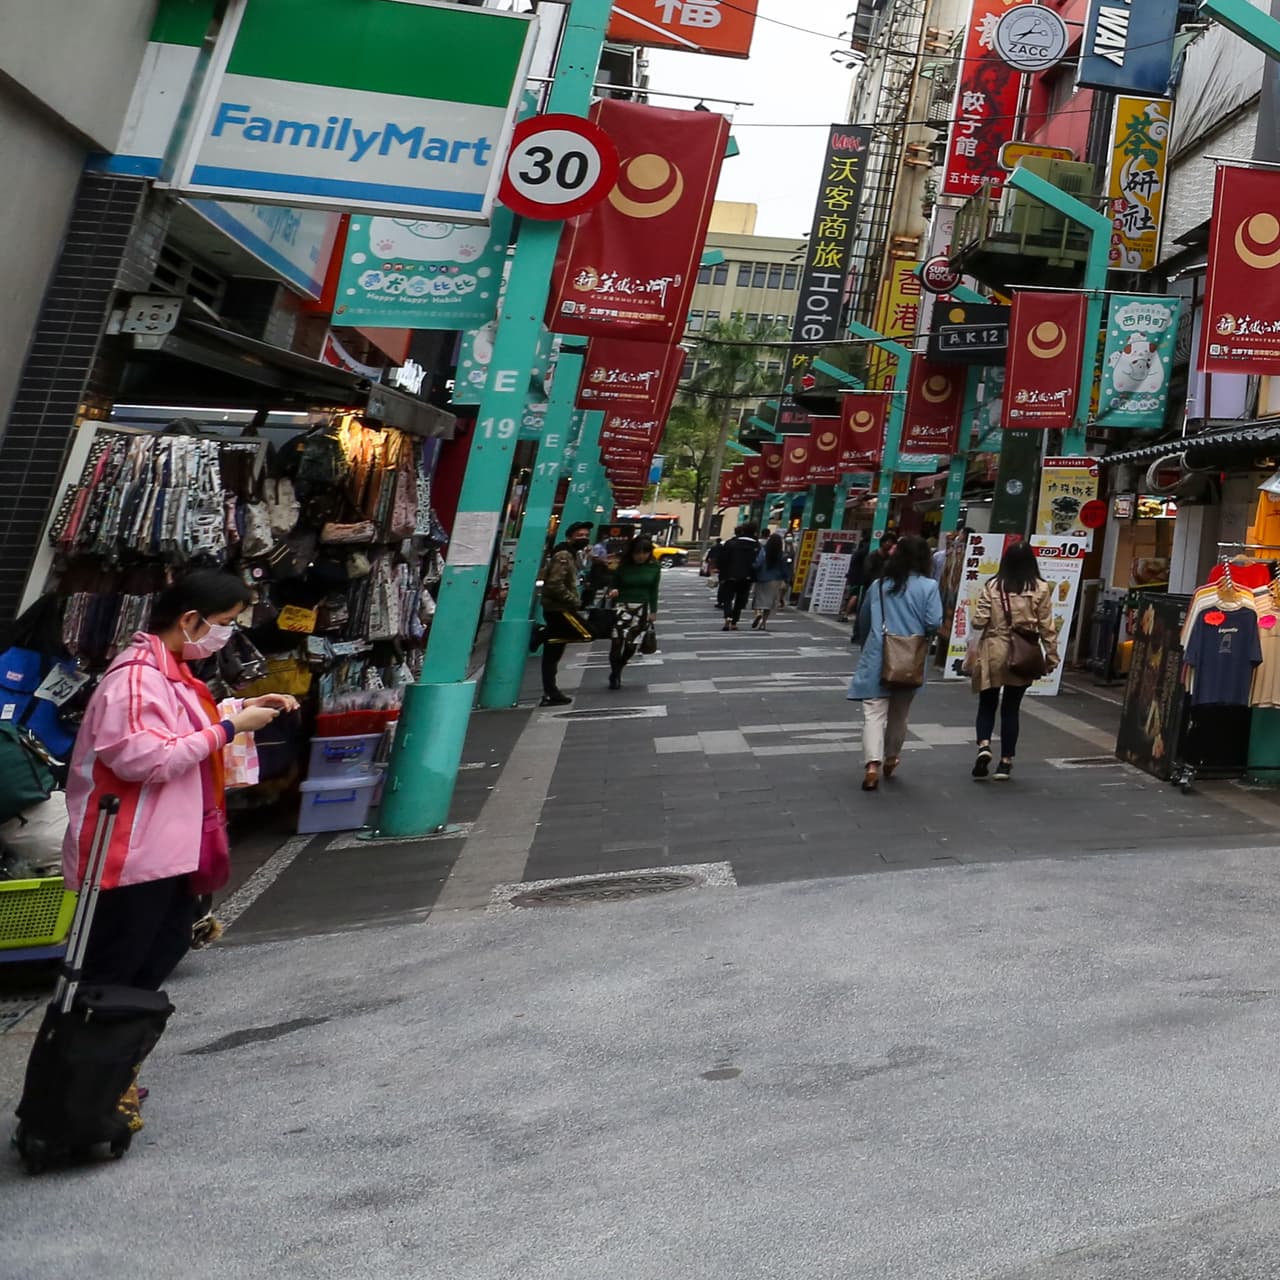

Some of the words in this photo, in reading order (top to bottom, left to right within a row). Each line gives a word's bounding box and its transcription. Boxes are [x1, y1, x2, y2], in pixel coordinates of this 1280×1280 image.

[1093, 5, 1131, 67] WAY
[1008, 43, 1049, 58] ZACC
[954, 90, 986, 158] 餃子館
[211, 102, 492, 171] FamilyMart
[519, 145, 590, 190] 30
[812, 156, 859, 268] 沃客商旅
[928, 265, 953, 274] SUPE
[366, 292, 396, 302] Happy
[400, 295, 428, 304] Happy
[801, 273, 842, 340] Hote
[1123, 315, 1168, 328] 西門町
[494, 371, 519, 392] E
[481, 418, 515, 439] 19
[545, 434, 561, 447] E
[537, 463, 561, 475] 17
[577, 463, 588, 473] E
[966, 535, 985, 581] 珍珠奶茶
[1040, 548, 1058, 557] TOP
[1060, 543, 1080, 557] 10
